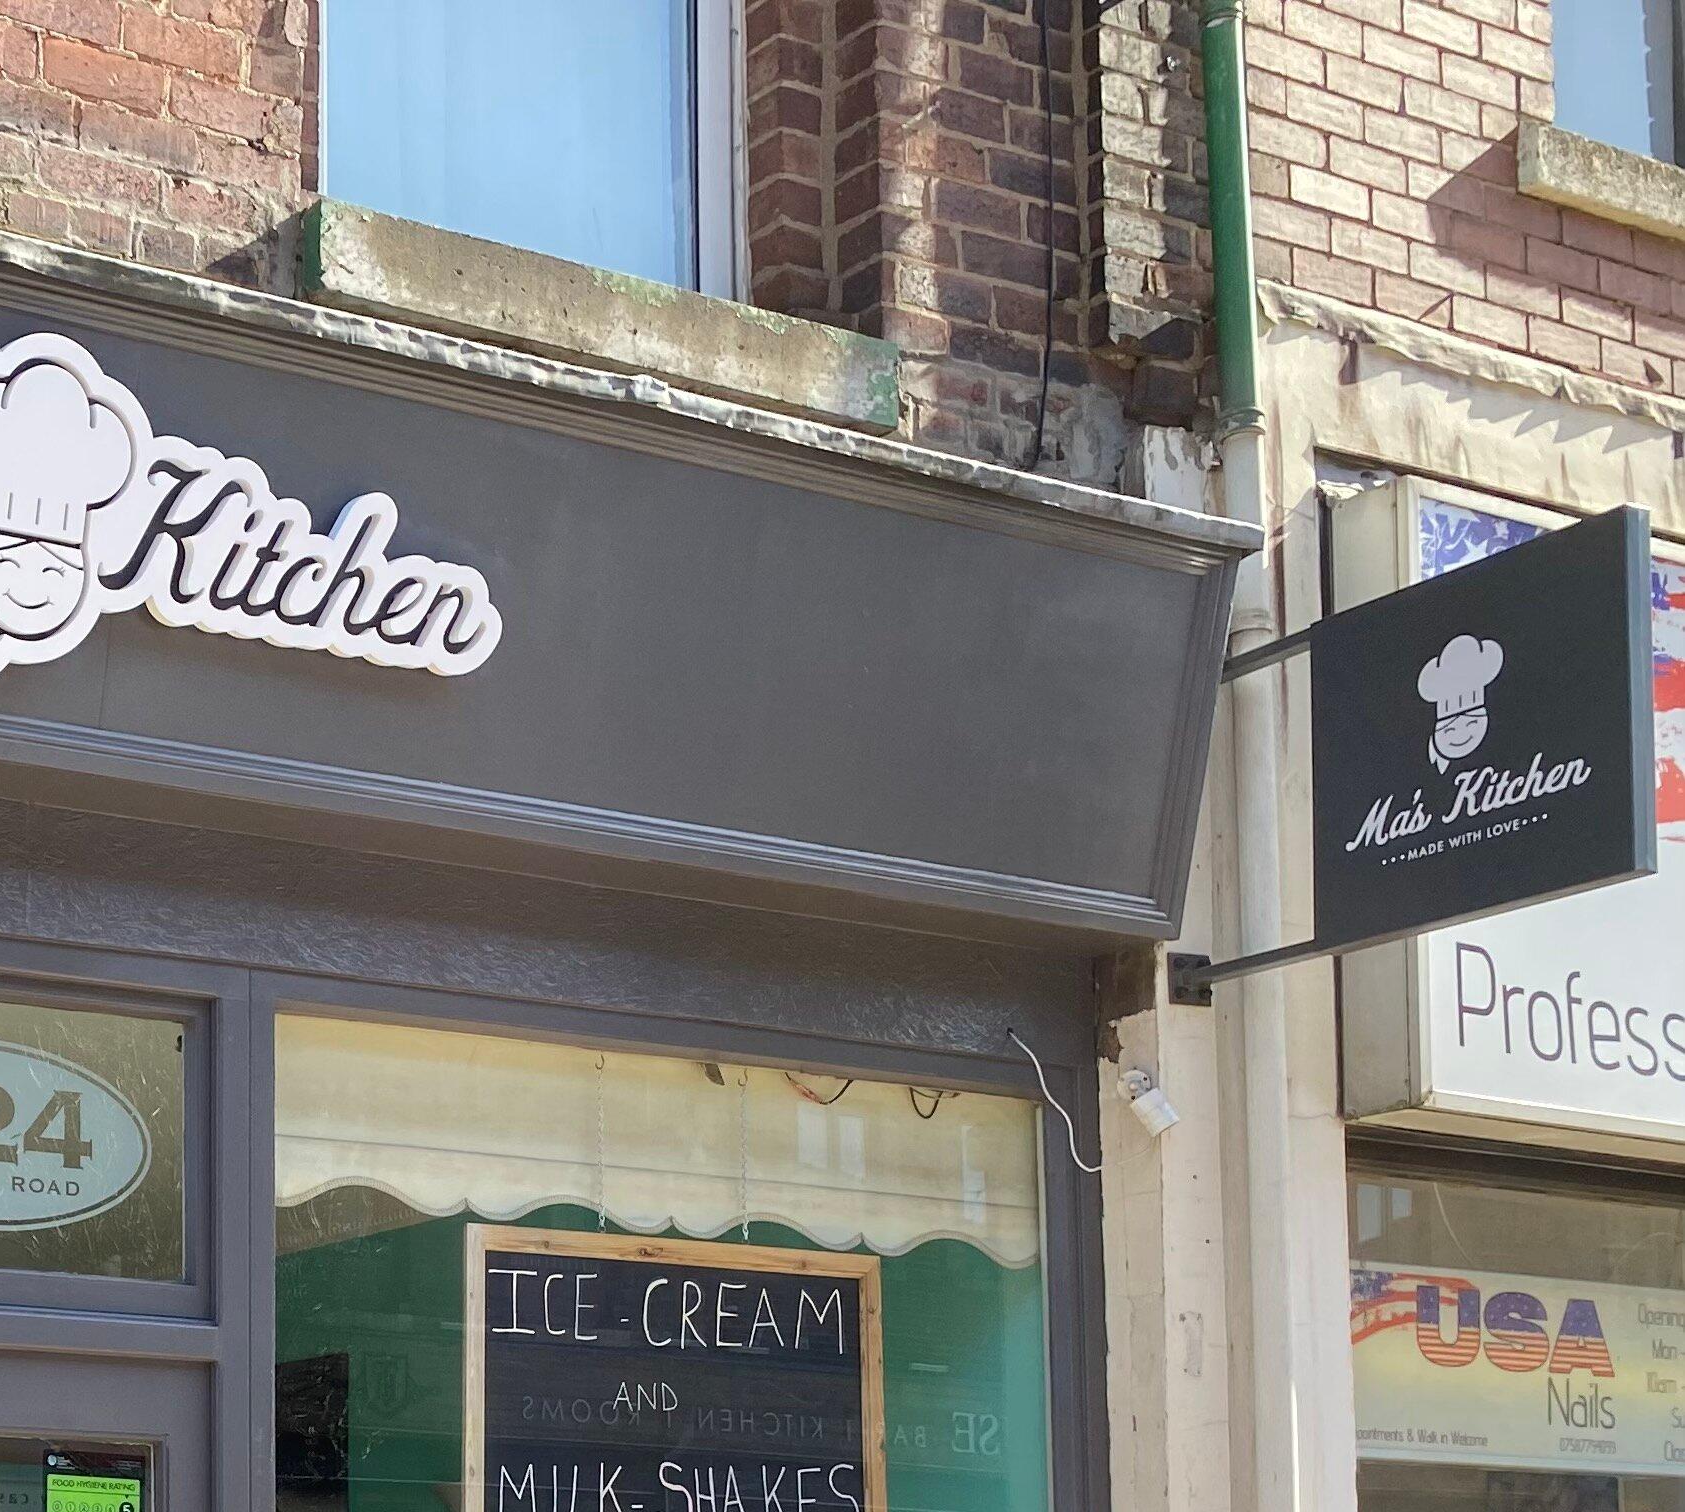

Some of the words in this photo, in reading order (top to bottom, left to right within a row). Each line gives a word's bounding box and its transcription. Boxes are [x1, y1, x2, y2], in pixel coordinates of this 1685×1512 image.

[99, 458, 483, 656] Kitchen
[1345, 789, 1432, 851] Ma's
[1442, 752, 1591, 823] Kitchen
[1407, 840, 1444, 861] MADE
[1449, 829, 1482, 849] WITH
[1487, 819, 1521, 838] LOVE
[1456, 942, 1685, 1081] Profess
[12, 1176, 80, 1197] ROAD
[1417, 1285, 1615, 1377] USA
[613, 1381, 678, 1412] AND
[1548, 1377, 1616, 1429] Nails
[1417, 1429, 1437, 1444] Walk
[52, 1479, 74, 1487] FOOD
[76, 1480, 107, 1490] HYGIENE
[109, 1482, 135, 1491] RATING
